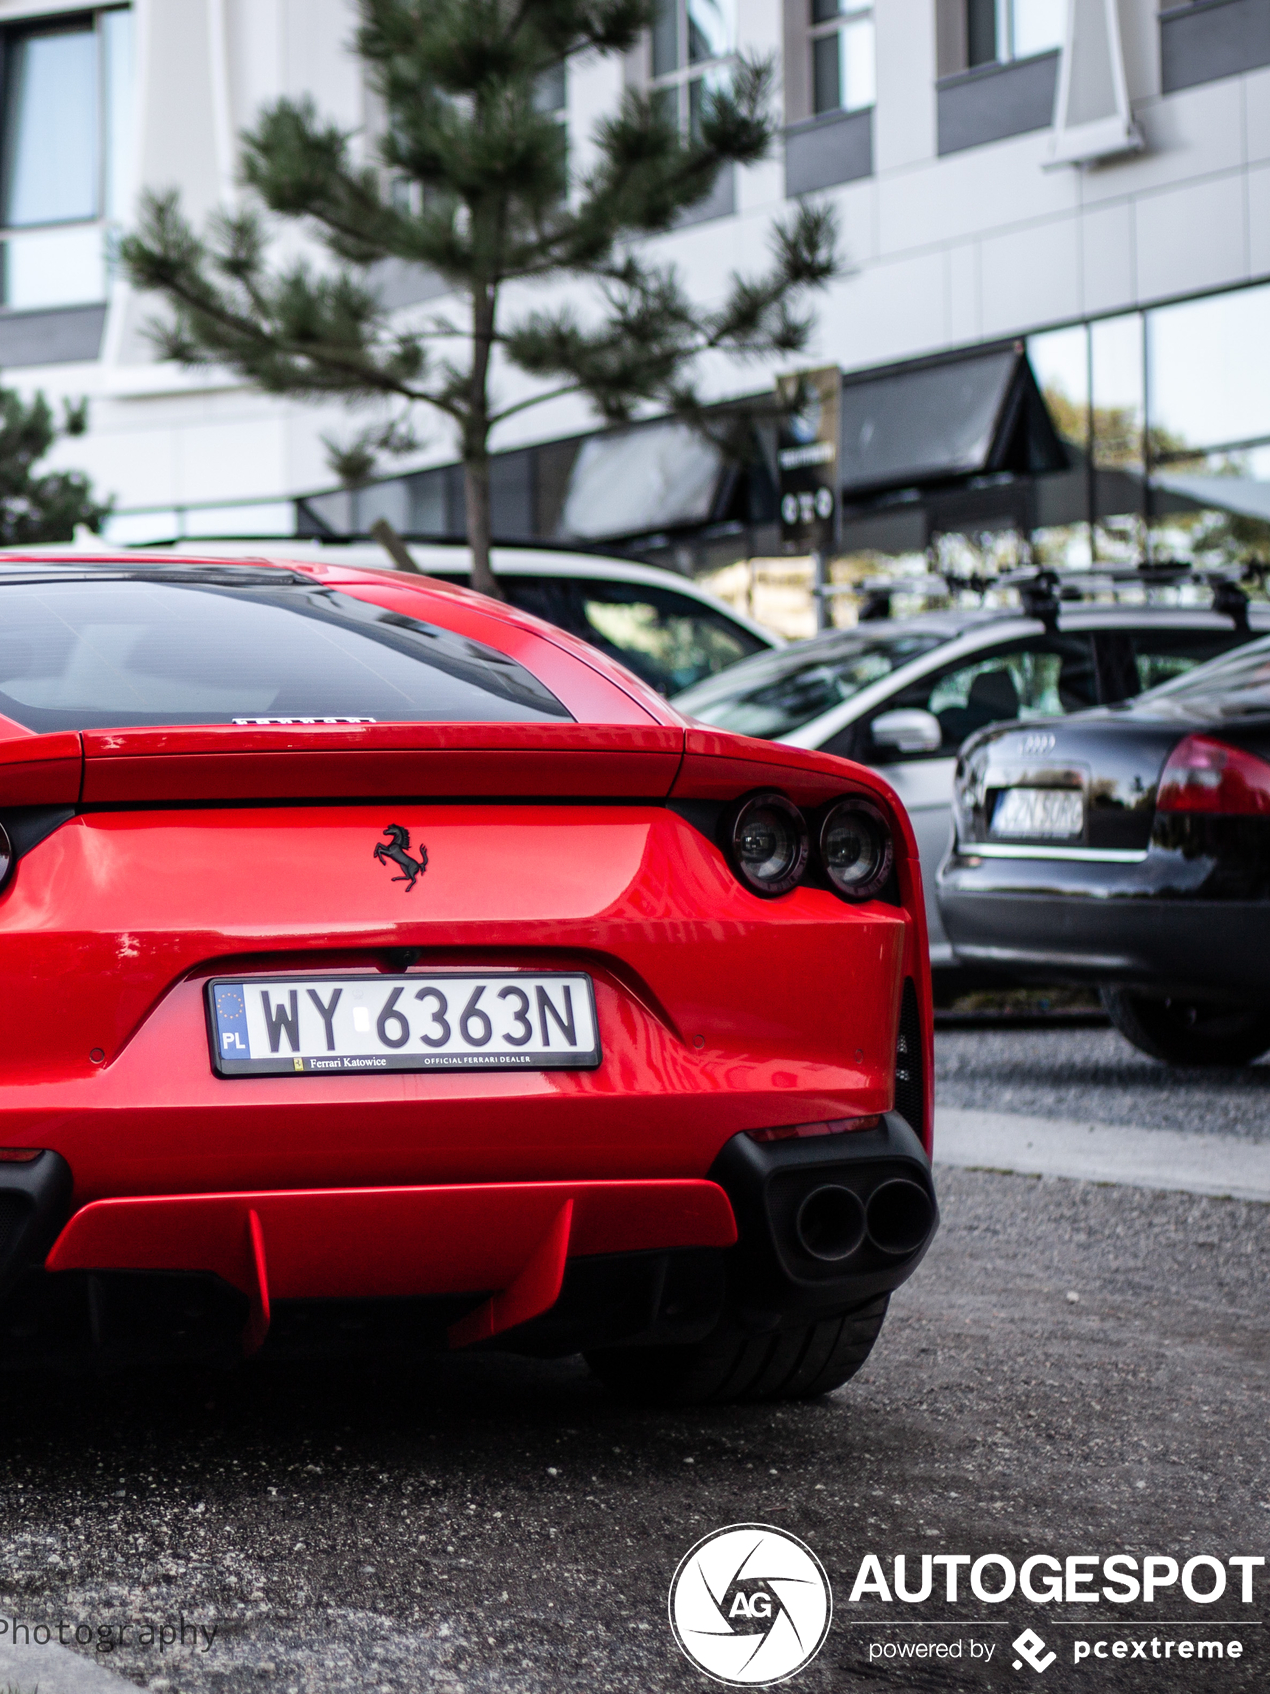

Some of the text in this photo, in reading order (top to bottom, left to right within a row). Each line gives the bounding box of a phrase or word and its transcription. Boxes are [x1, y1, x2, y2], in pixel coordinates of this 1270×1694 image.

[260, 985, 577, 1052] WY 6363N
[222, 1033, 246, 1050] PL
[310, 1057, 387, 1068] Ferrari Katowice
[500, 1055, 531, 1063] DEALER
